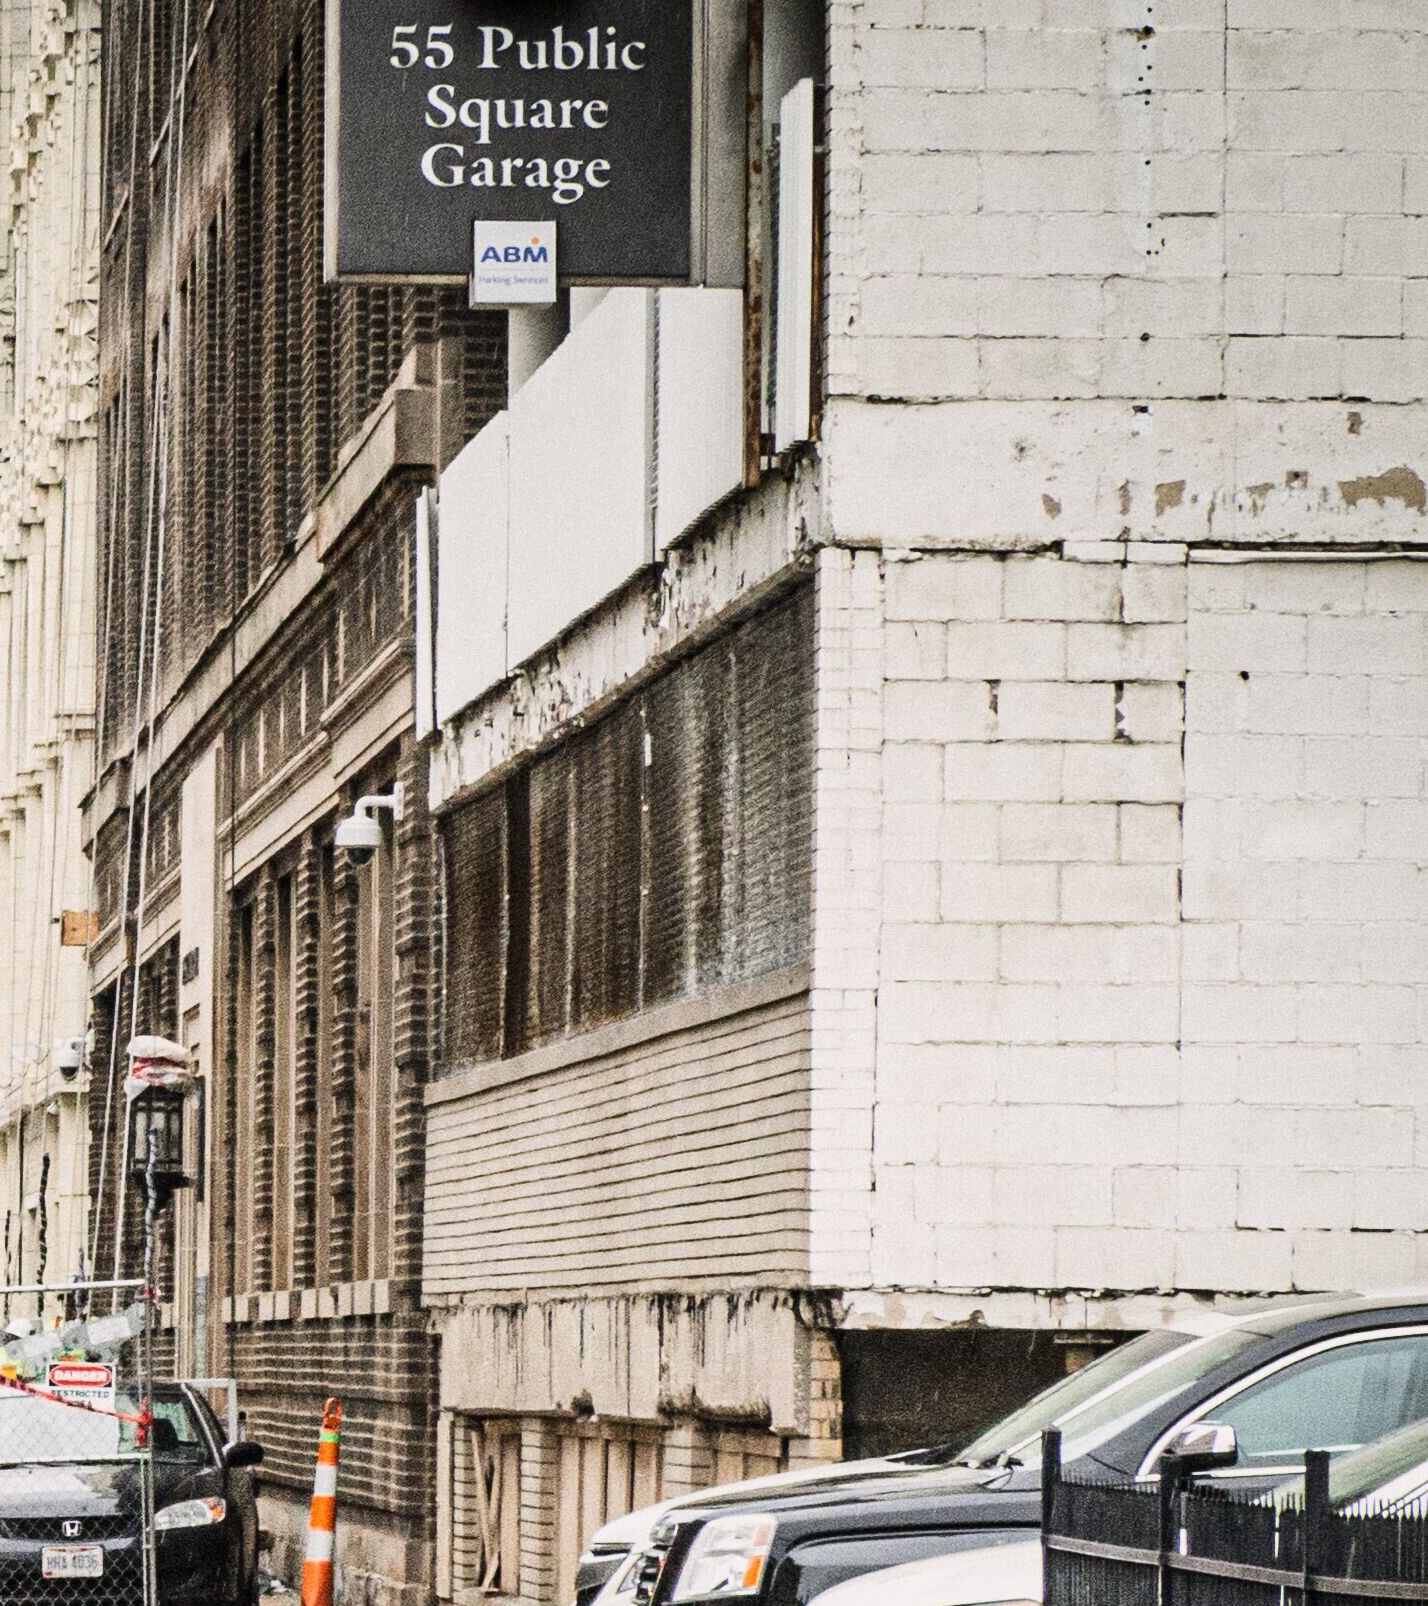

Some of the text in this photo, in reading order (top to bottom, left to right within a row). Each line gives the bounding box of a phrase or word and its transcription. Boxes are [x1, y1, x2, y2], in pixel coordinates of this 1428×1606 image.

[389, 23, 646, 71] 55 Public
[424, 83, 609, 145] Square
[420, 143, 612, 204] Garage
[480, 246, 548, 263] ABM
[54, 1369, 107, 1382] DANGER
[50, 1389, 110, 1399] RESTRICTED
